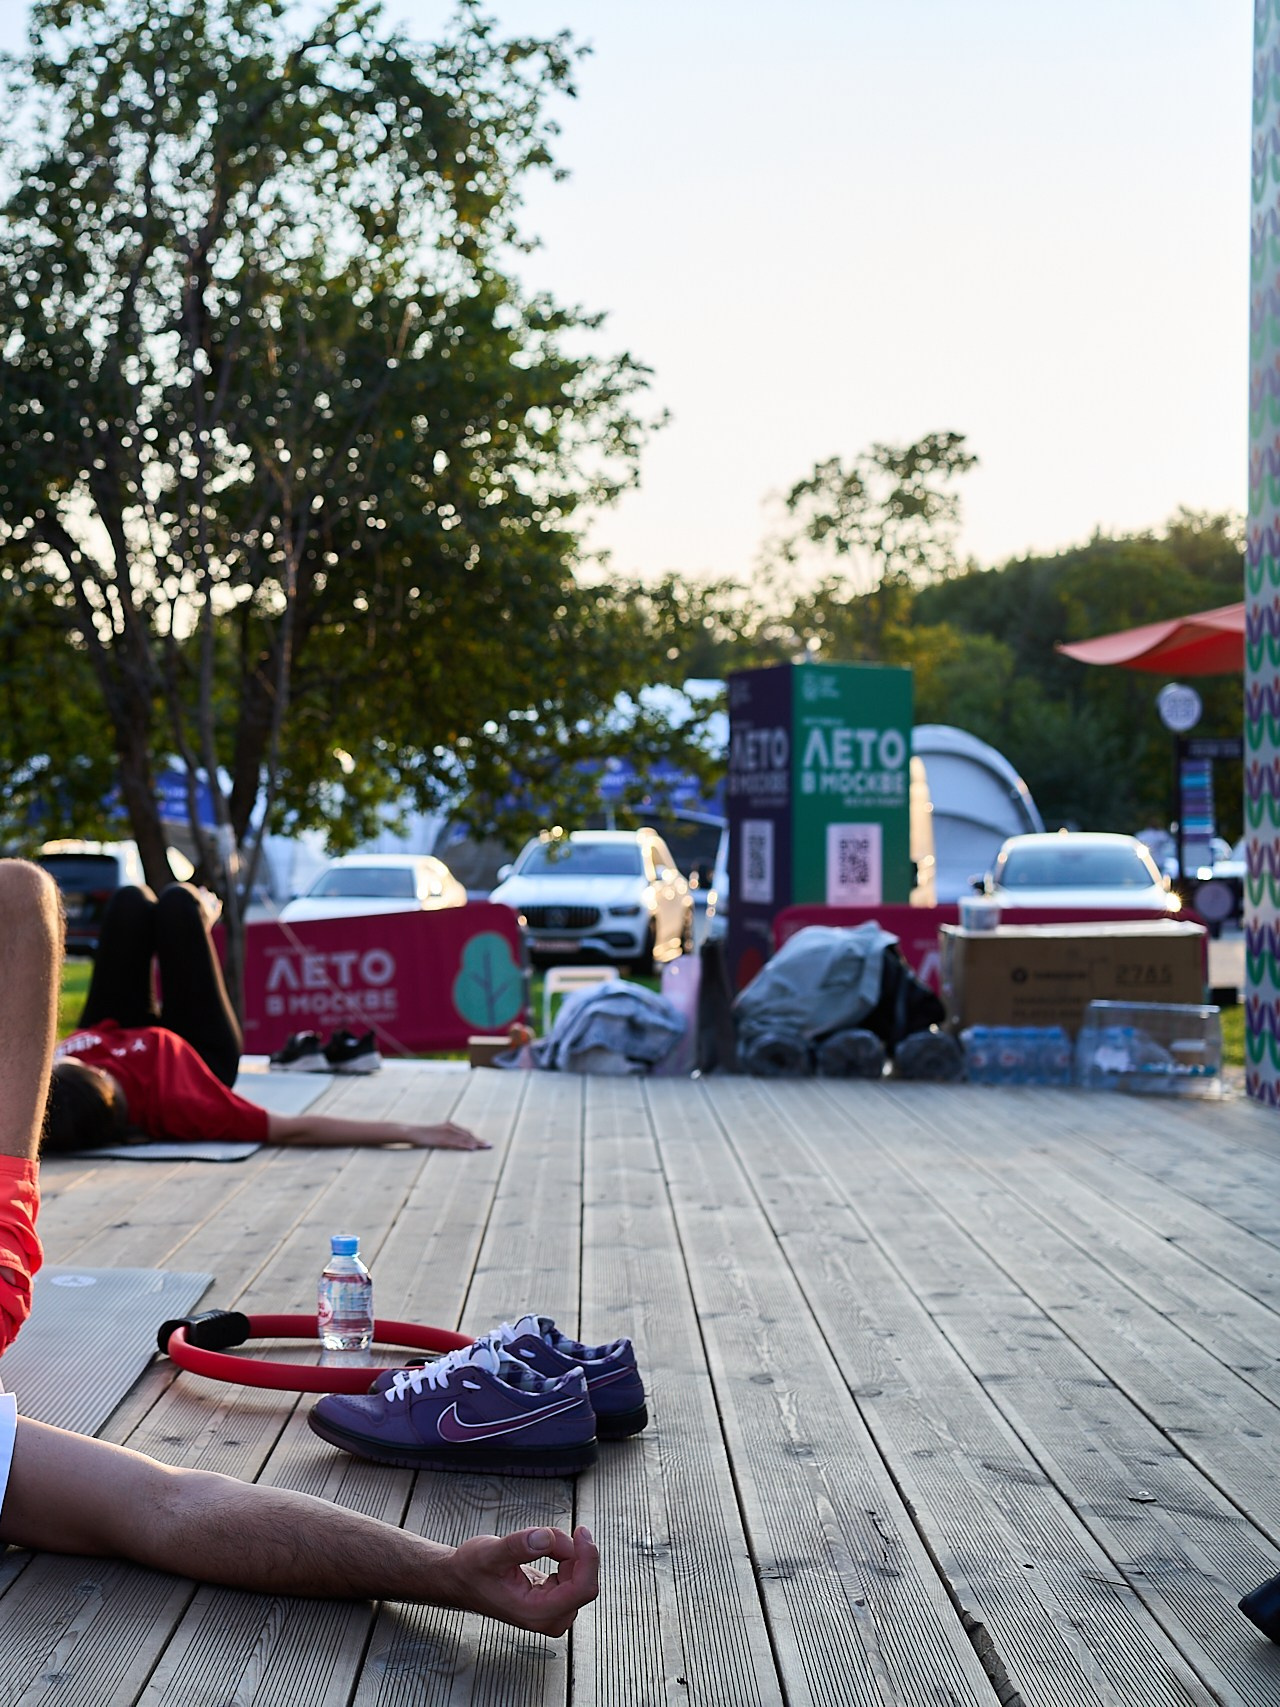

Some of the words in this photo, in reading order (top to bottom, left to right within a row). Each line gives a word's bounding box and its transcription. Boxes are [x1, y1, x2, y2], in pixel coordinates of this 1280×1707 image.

[803, 728, 907, 769] ЛЕТО
[801, 772, 817, 794] В
[821, 772, 906, 794] МОСКВЕ
[265, 948, 396, 991] ЛЕТО
[265, 994, 285, 1016] В
[288, 989, 399, 1015] МОСКВЕ
